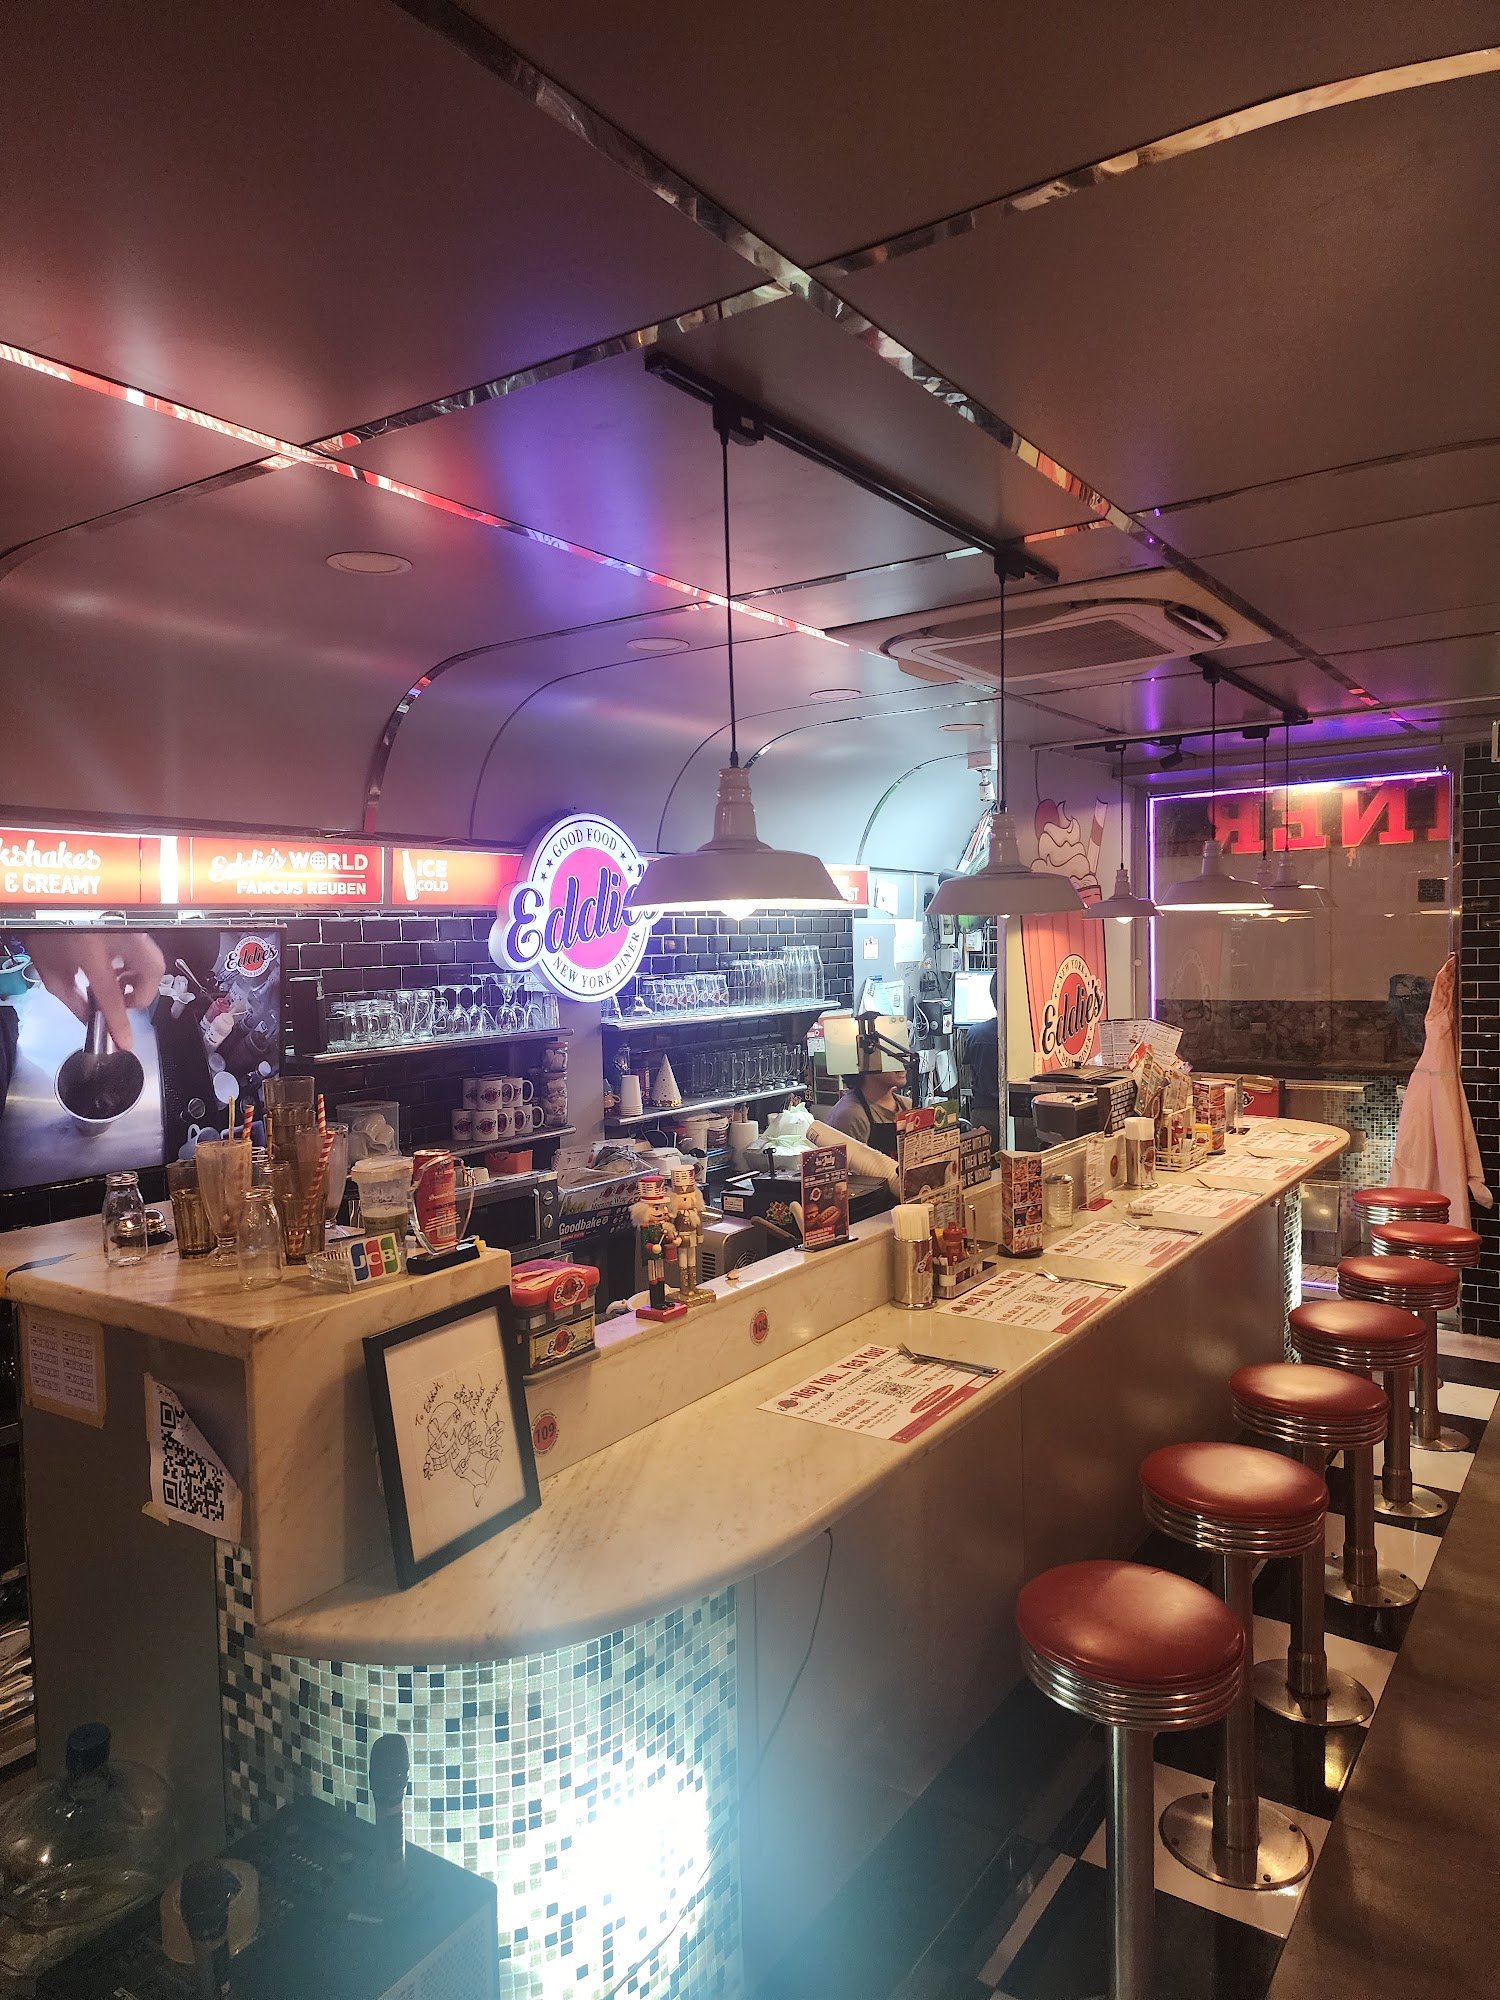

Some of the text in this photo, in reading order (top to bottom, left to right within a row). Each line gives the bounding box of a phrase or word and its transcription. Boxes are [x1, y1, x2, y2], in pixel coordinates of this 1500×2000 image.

[552, 828, 617, 858] GOOD FOOD
[208, 848, 369, 882] Eddie's WORLD
[417, 859, 448, 877] ICE
[22, 872, 101, 895] CREAMY
[236, 882, 367, 895] FAMOUS REUBEN
[416, 880, 449, 893] COLD
[226, 945, 278, 970] Eddie's
[552, 931, 641, 989] NEW YORK DINER
[1059, 960, 1085, 979] NEW YORK
[1042, 979, 1104, 1055] Eddie's
[351, 1236, 398, 1282] JCB
[790, 1385, 825, 1399] Hey
[838, 1359, 869, 1370] Yes
